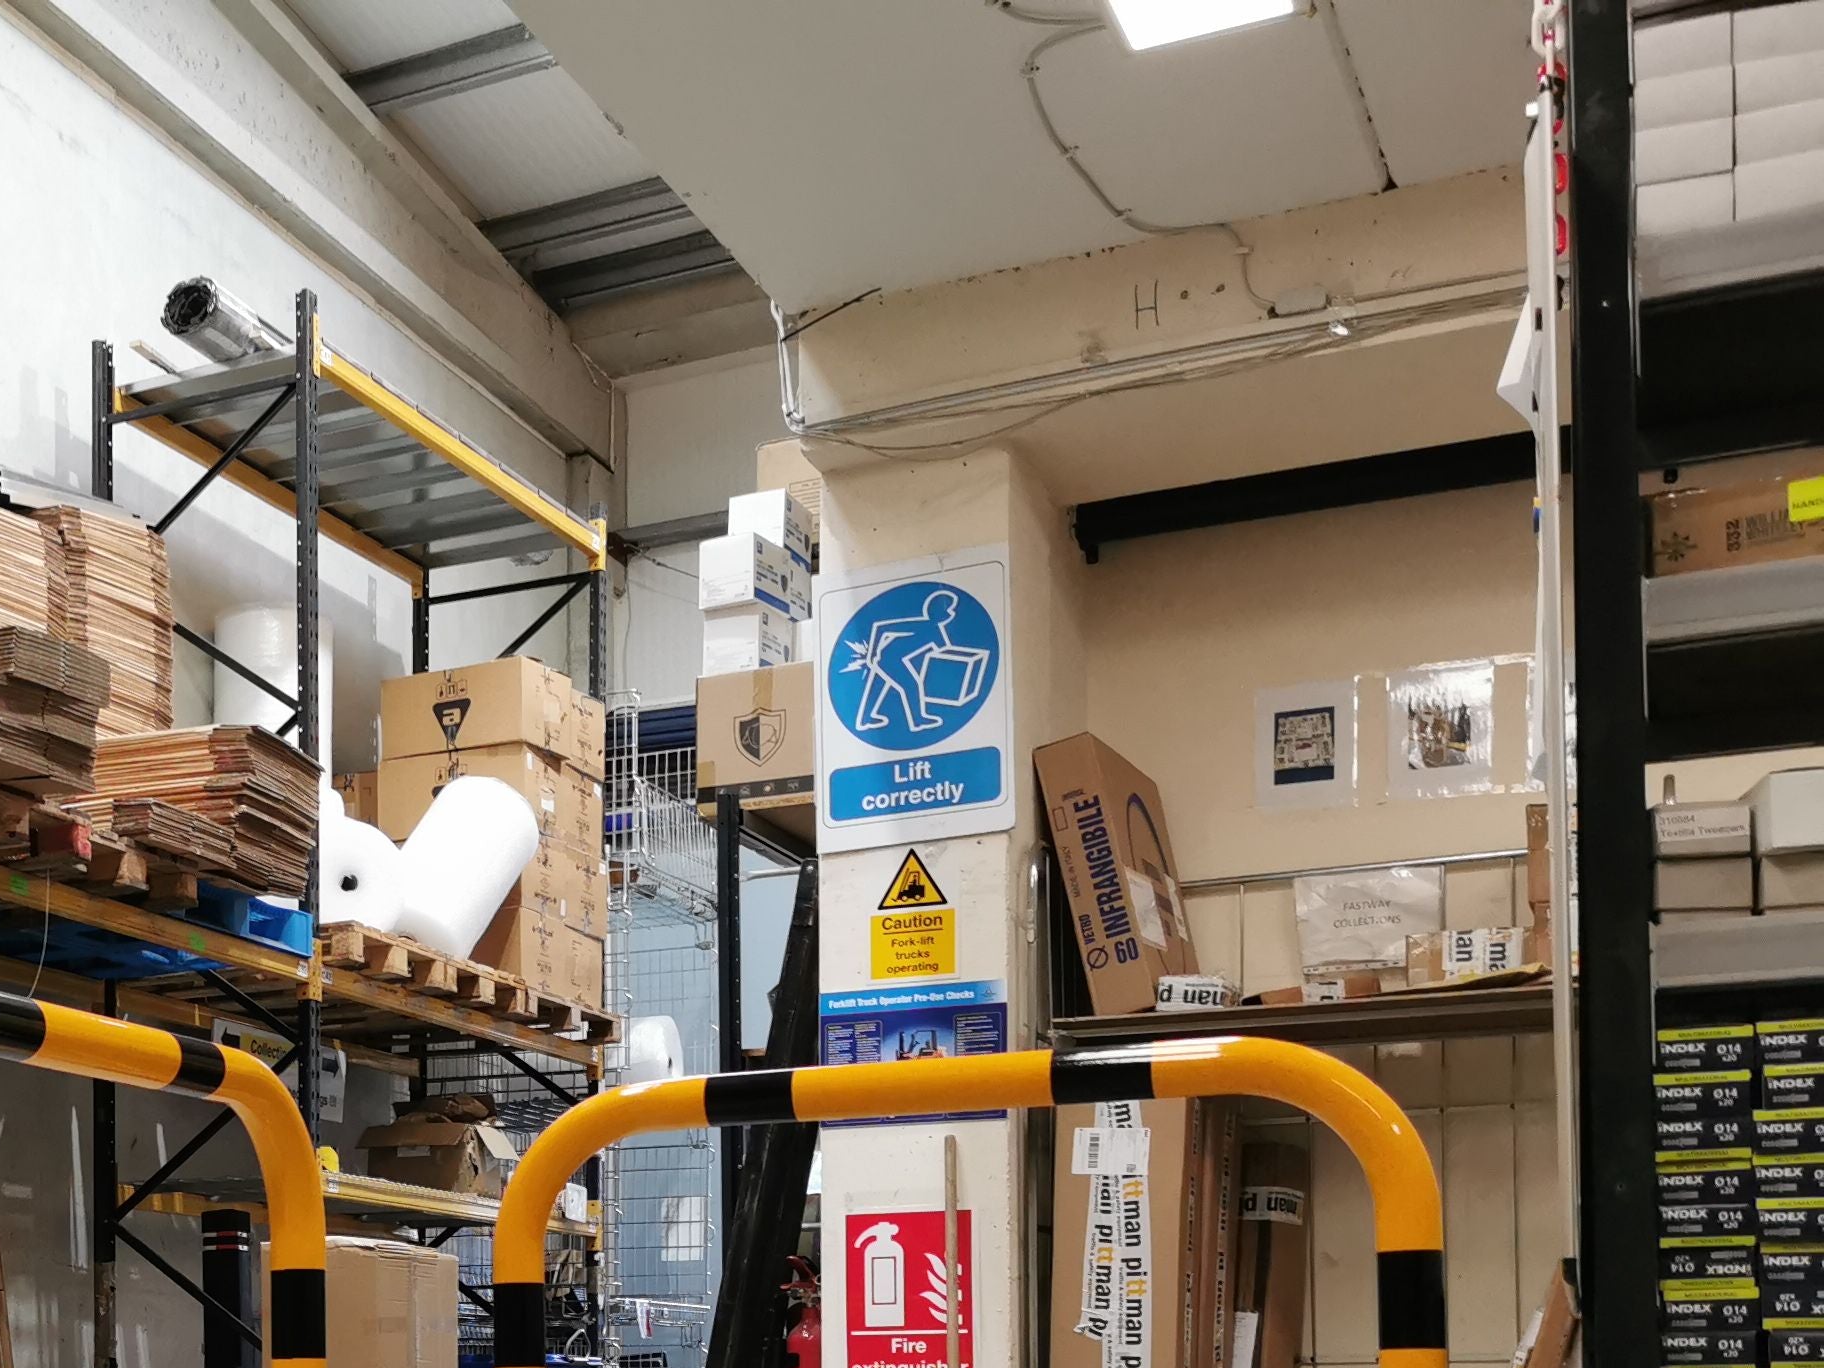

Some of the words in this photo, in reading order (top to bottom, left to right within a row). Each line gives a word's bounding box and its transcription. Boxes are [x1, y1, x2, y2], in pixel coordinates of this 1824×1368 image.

[894, 761, 932, 783] Lift
[862, 781, 964, 811] correctly
[1073, 794, 1132, 940] INFRANGIBILE
[1343, 900, 1392, 911] FASTWAY
[882, 914, 943, 931] Caution
[1079, 914, 1095, 945] VETRO
[891, 936, 935, 947] Fork-lift
[1114, 937, 1139, 964] 60
[895, 950, 930, 960] trucks
[886, 962, 939, 975] operating
[829, 999, 857, 1009] Forklift
[857, 998, 877, 1008] Truck
[879, 995, 912, 1006] Operator
[946, 990, 975, 1000] Checks
[1121, 1257, 1148, 1345] pittman
[891, 1338, 927, 1353] Fire
